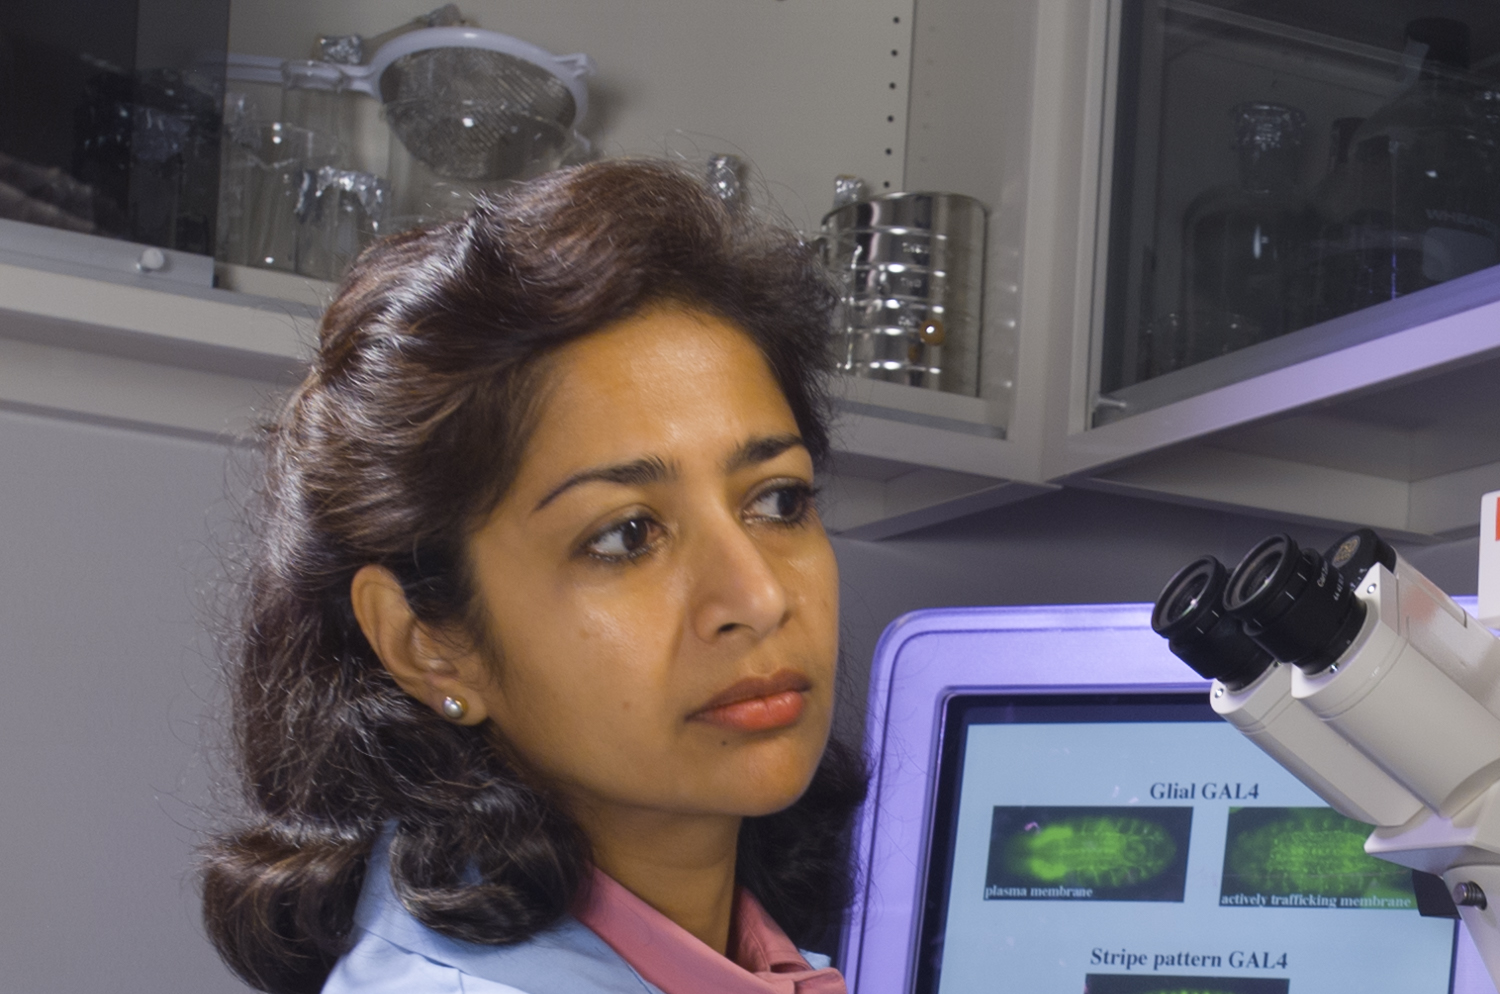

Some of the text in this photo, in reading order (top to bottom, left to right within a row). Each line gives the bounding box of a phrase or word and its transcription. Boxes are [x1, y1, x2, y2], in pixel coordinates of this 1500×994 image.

[1149, 782, 1260, 800] Glial GAL4
[984, 885, 1093, 899] plasma membrane
[1221, 893, 1411, 909] actively trafficking membrane
[1090, 948, 1288, 970] Stripe pattern GAL4
